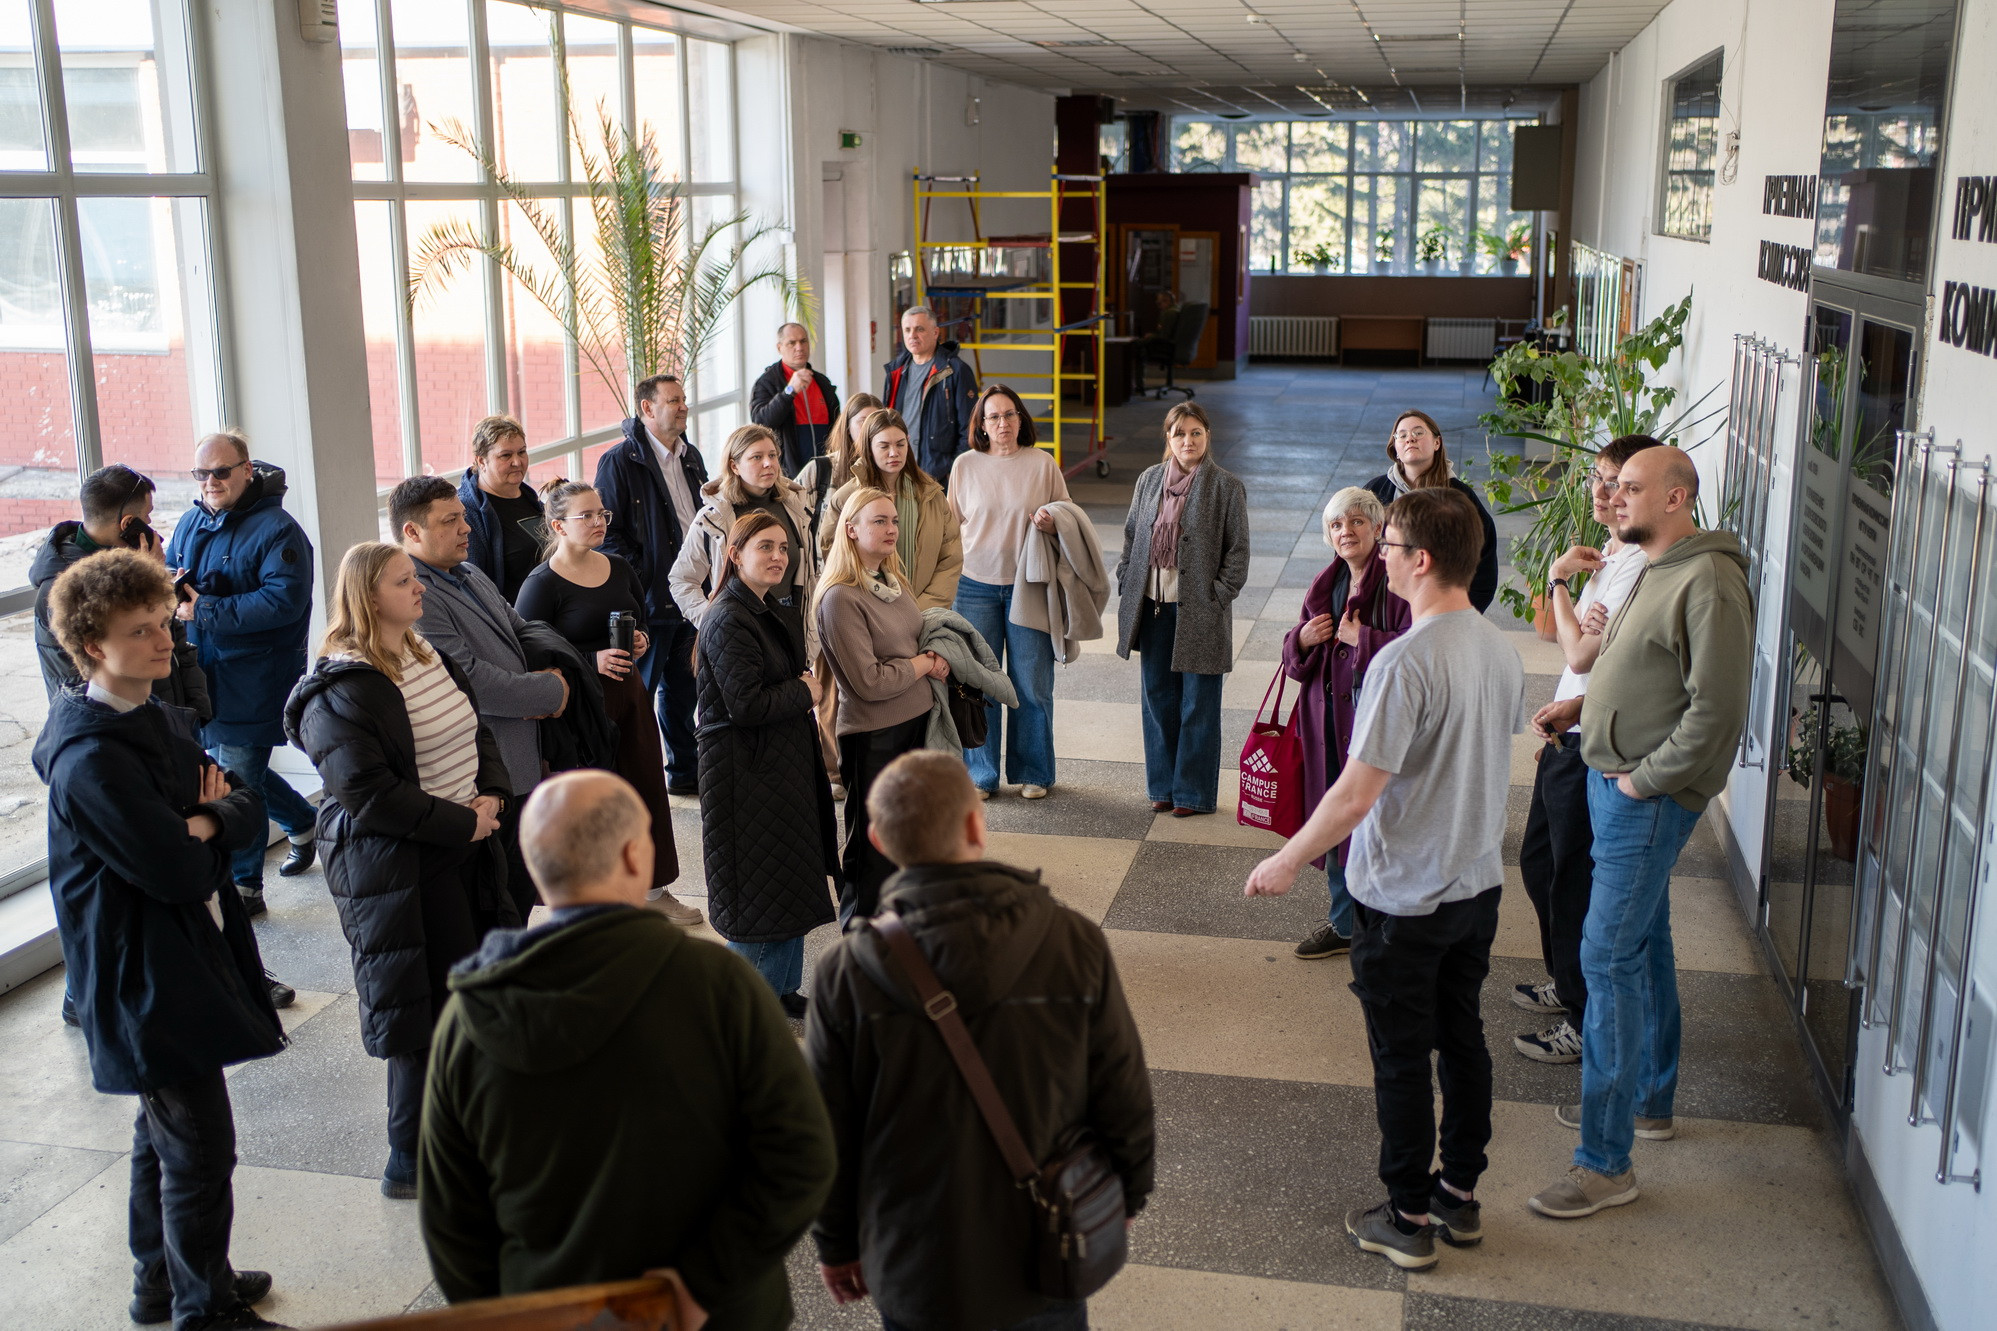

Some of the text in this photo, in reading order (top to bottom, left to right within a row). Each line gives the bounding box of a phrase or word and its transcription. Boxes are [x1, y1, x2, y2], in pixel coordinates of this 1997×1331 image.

[1762, 175, 1817, 219] ПРИЕМНАЯ
[1952, 176, 1997, 244] ПРИ
[1758, 239, 1812, 293] КОМИССИЯ
[1241, 771, 1278, 790] CAMPUS
